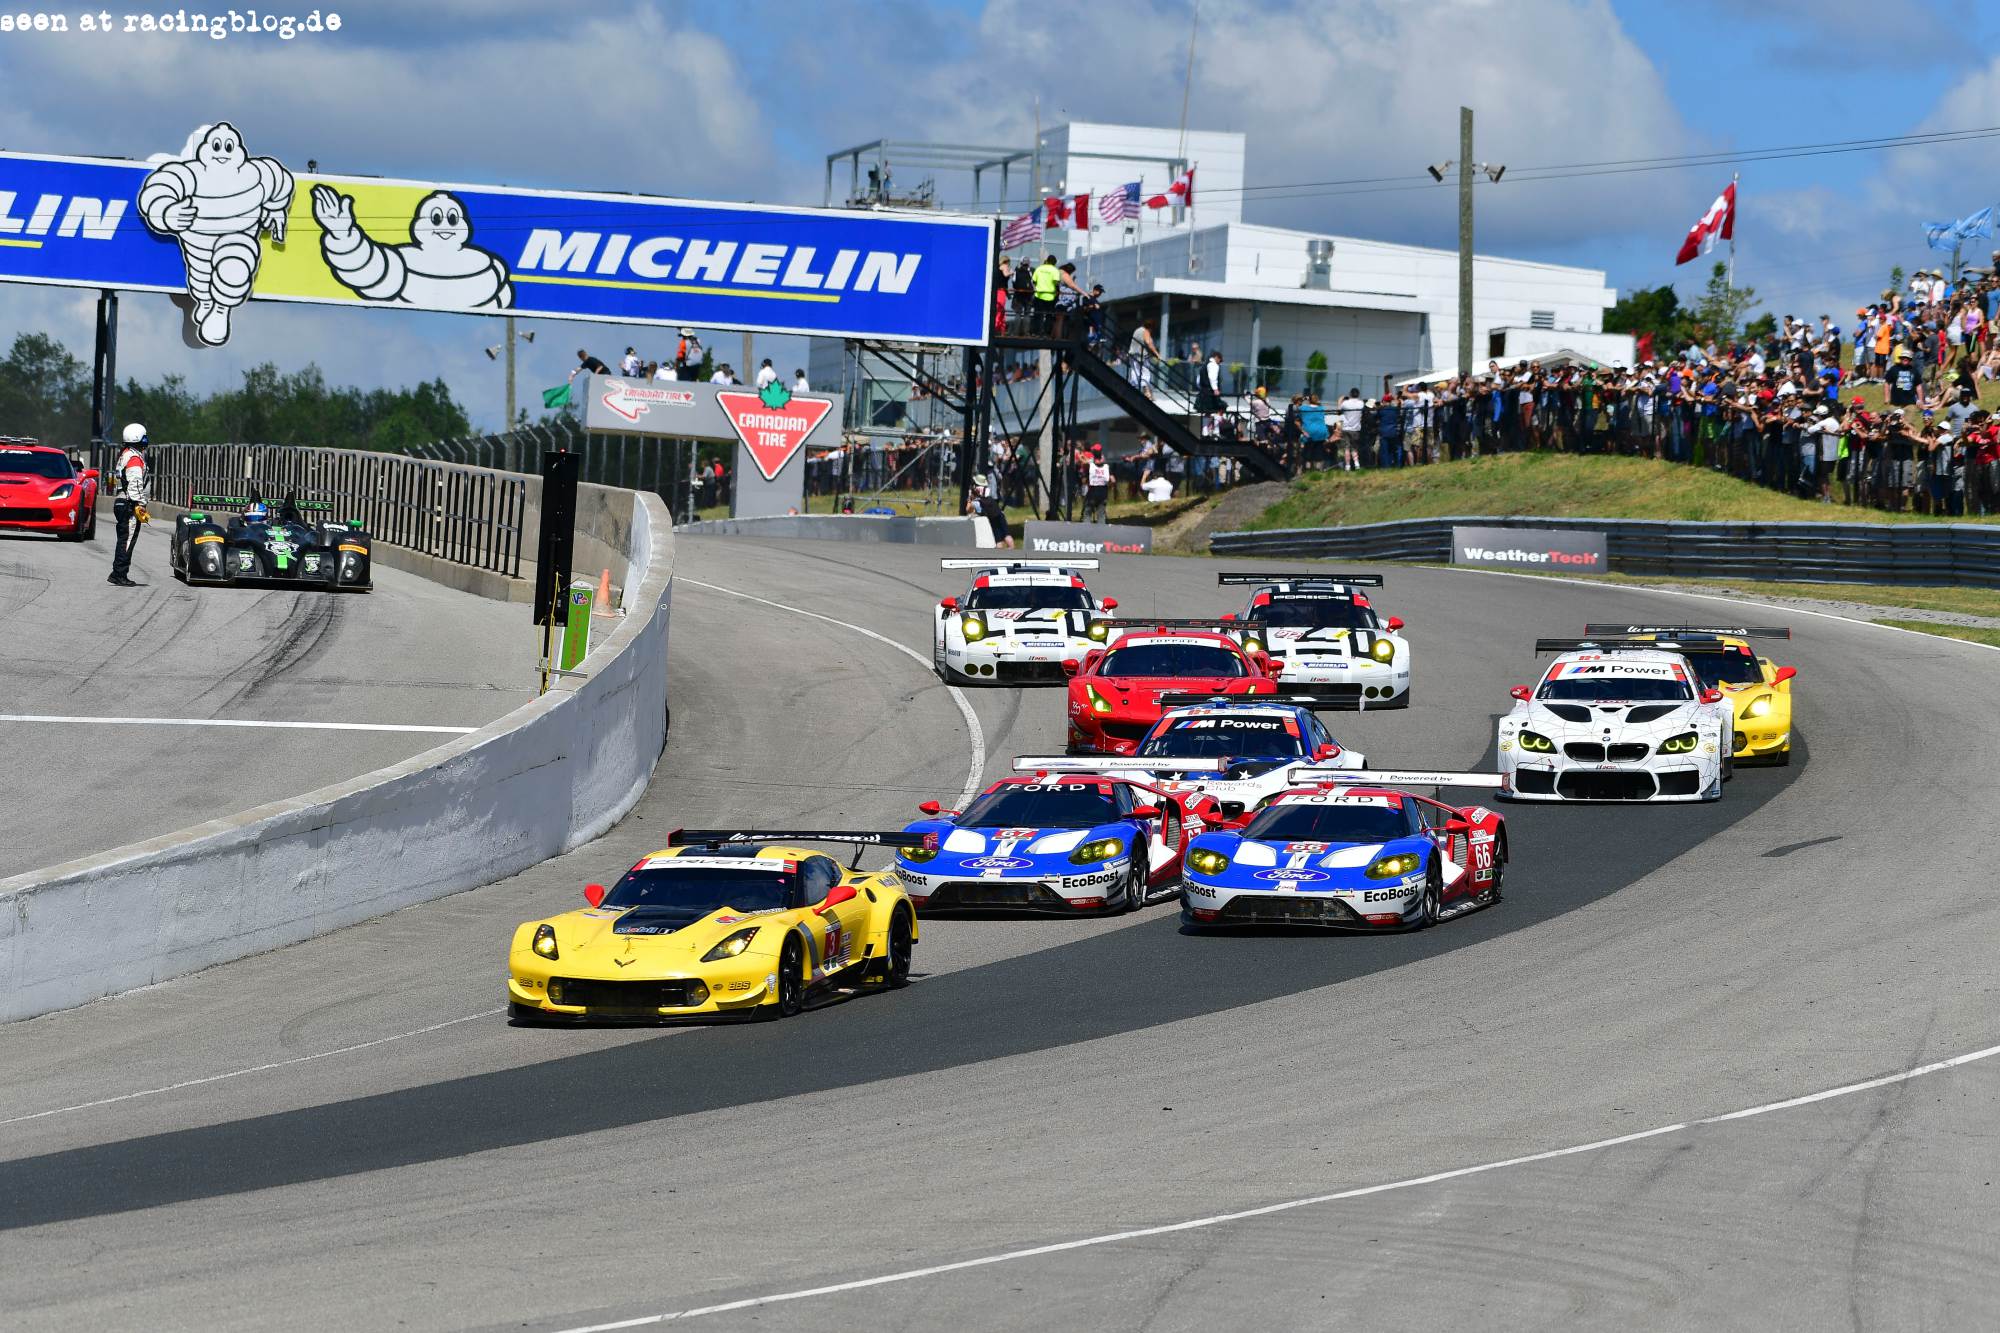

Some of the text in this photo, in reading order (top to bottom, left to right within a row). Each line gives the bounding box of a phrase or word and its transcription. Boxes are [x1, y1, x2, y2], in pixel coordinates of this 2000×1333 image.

[517, 228, 922, 294] MICHELIN
[739, 412, 808, 432] CANADIAN
[757, 431, 787, 448] TIRE
[225, 496, 277, 506] Money
[1033, 538, 1142, 554] WeatherTech
[1464, 547, 1597, 565] WeatherTech
[1611, 664, 1670, 675] Power
[1220, 719, 1281, 730] Power
[1389, 774, 1453, 783] Powered by
[1005, 783, 1086, 792] FORD
[1291, 795, 1374, 804] FORD
[1001, 830, 1030, 838] 67
[1291, 843, 1322, 852] 66
[1475, 843, 1491, 869] 66
[972, 857, 1021, 867] Ford
[1062, 869, 1120, 889] EcoBoost
[1267, 868, 1317, 880] Ford
[1364, 884, 1419, 903] EcoBoost
[728, 980, 751, 991] BBS
